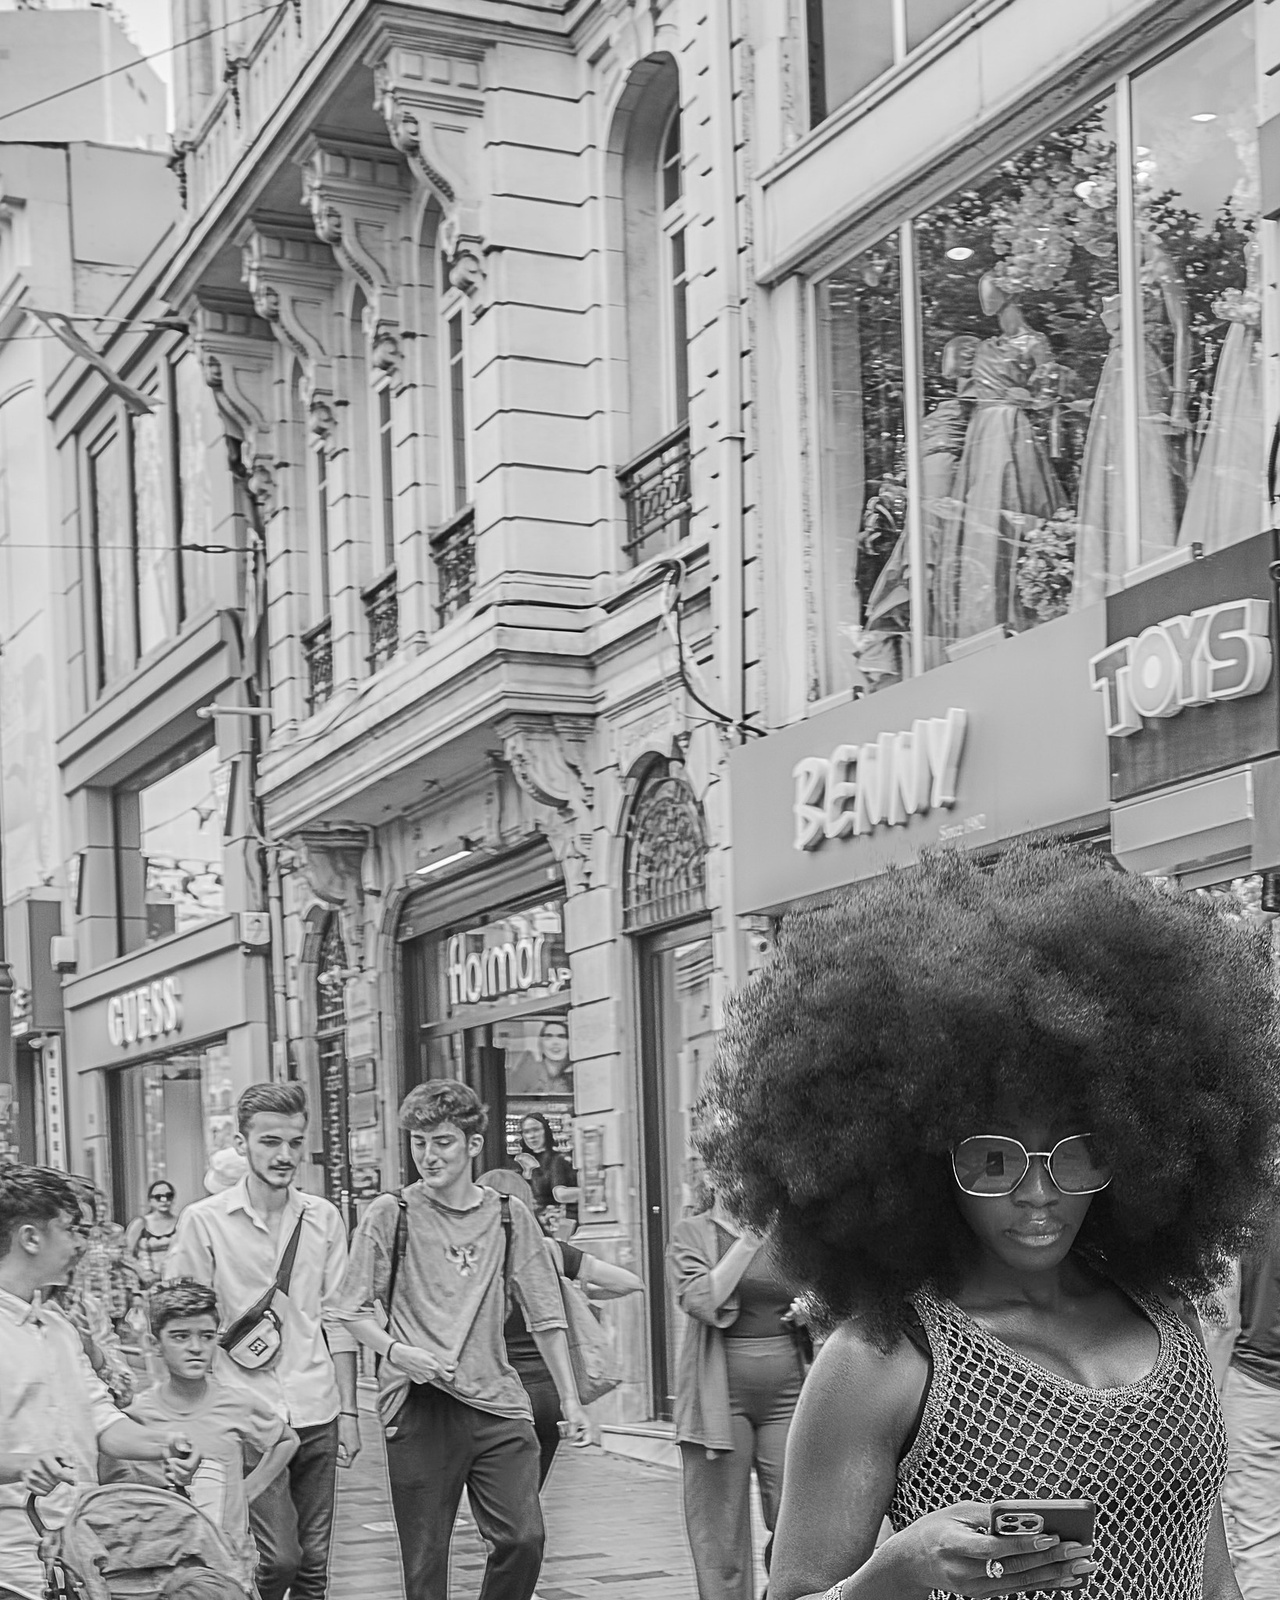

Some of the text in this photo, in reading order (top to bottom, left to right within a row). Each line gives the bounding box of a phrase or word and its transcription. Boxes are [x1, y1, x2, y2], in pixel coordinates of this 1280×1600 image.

[1089, 598, 1273, 737] TOYS
[793, 707, 967, 852] BENNY
[108, 976, 180, 1047] GUESS
[448, 932, 545, 1005] flormar
